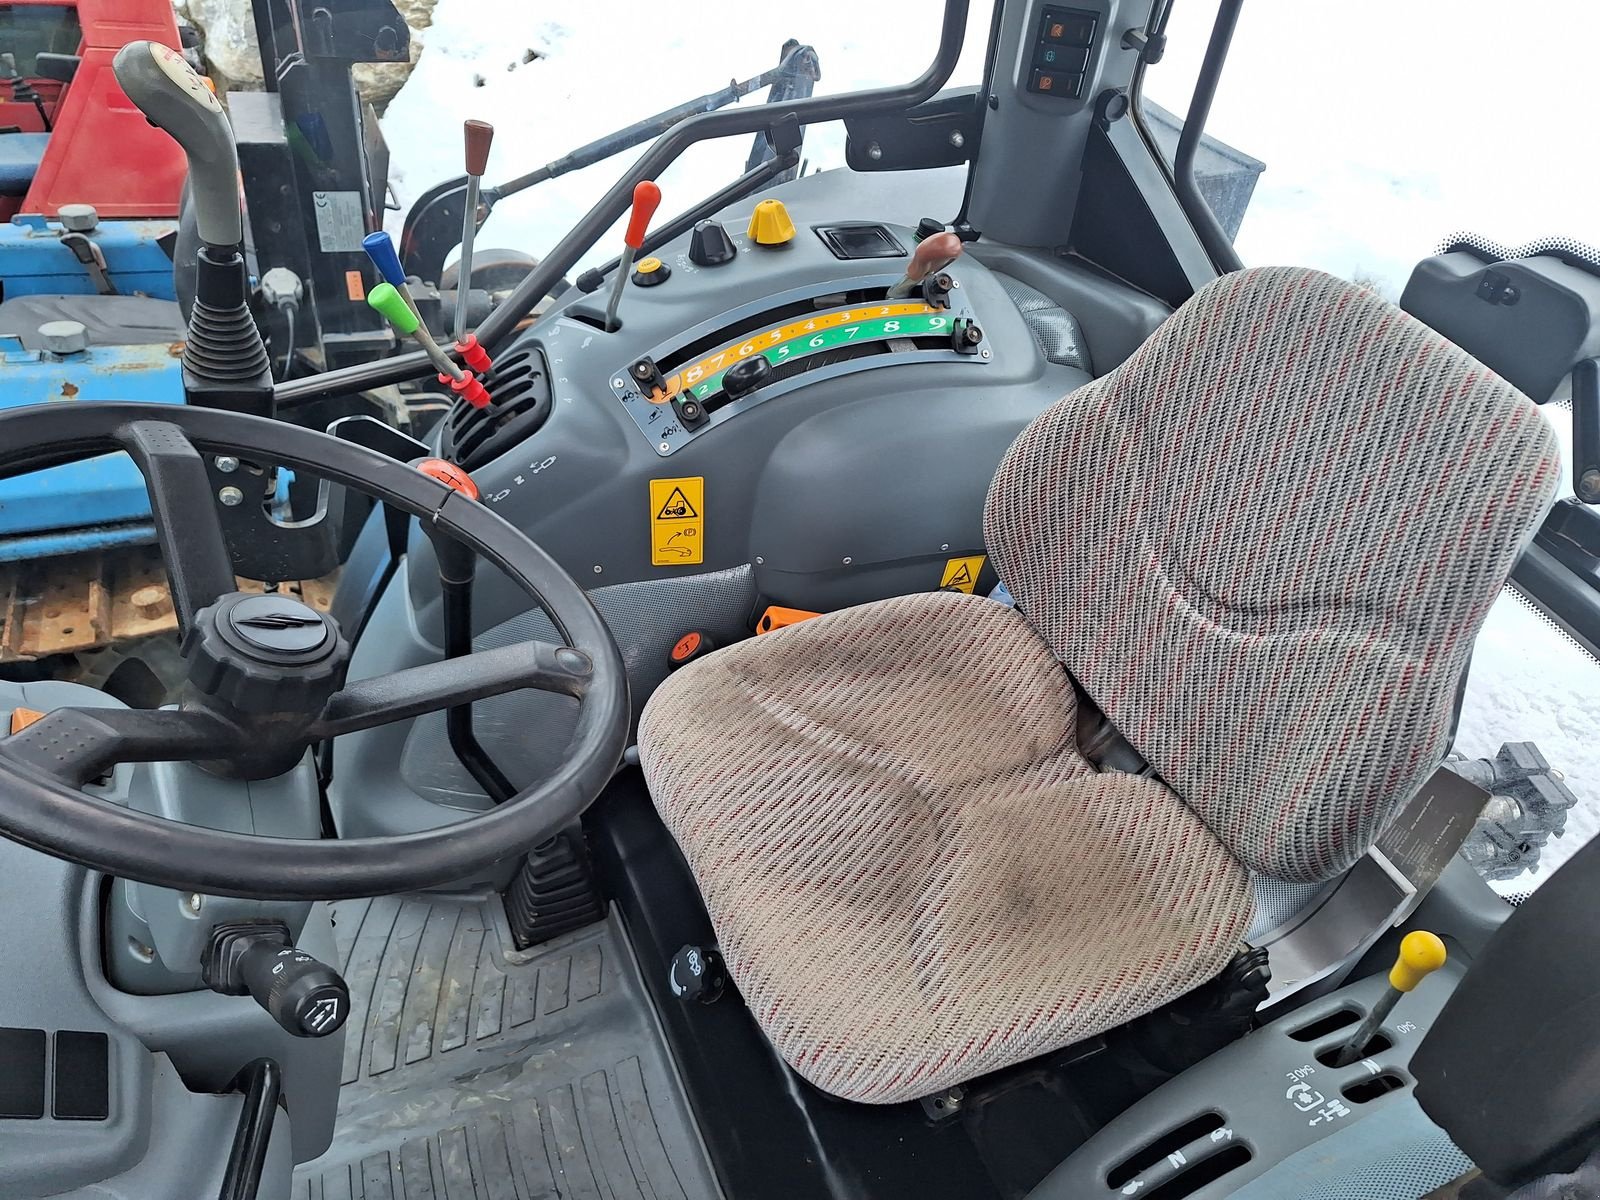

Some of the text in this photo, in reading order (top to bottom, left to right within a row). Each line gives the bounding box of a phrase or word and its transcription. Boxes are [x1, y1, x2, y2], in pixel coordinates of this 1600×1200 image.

[686, 366, 704, 383] 8
[711, 353, 726, 369] 7
[738, 341, 754, 356] 6
[770, 330, 782, 343] 5
[803, 319, 816, 330] 4
[840, 312, 851, 322] 3
[880, 307, 889, 315] 2
[699, 317, 947, 395] 2 5 6 7 8 9
[514, 475, 525, 485] N
[1396, 1020, 1417, 1034] 540
[1286, 1064, 1315, 1082] 540E
[1361, 1059, 1381, 1075] N
[1167, 1150, 1187, 1169] N
